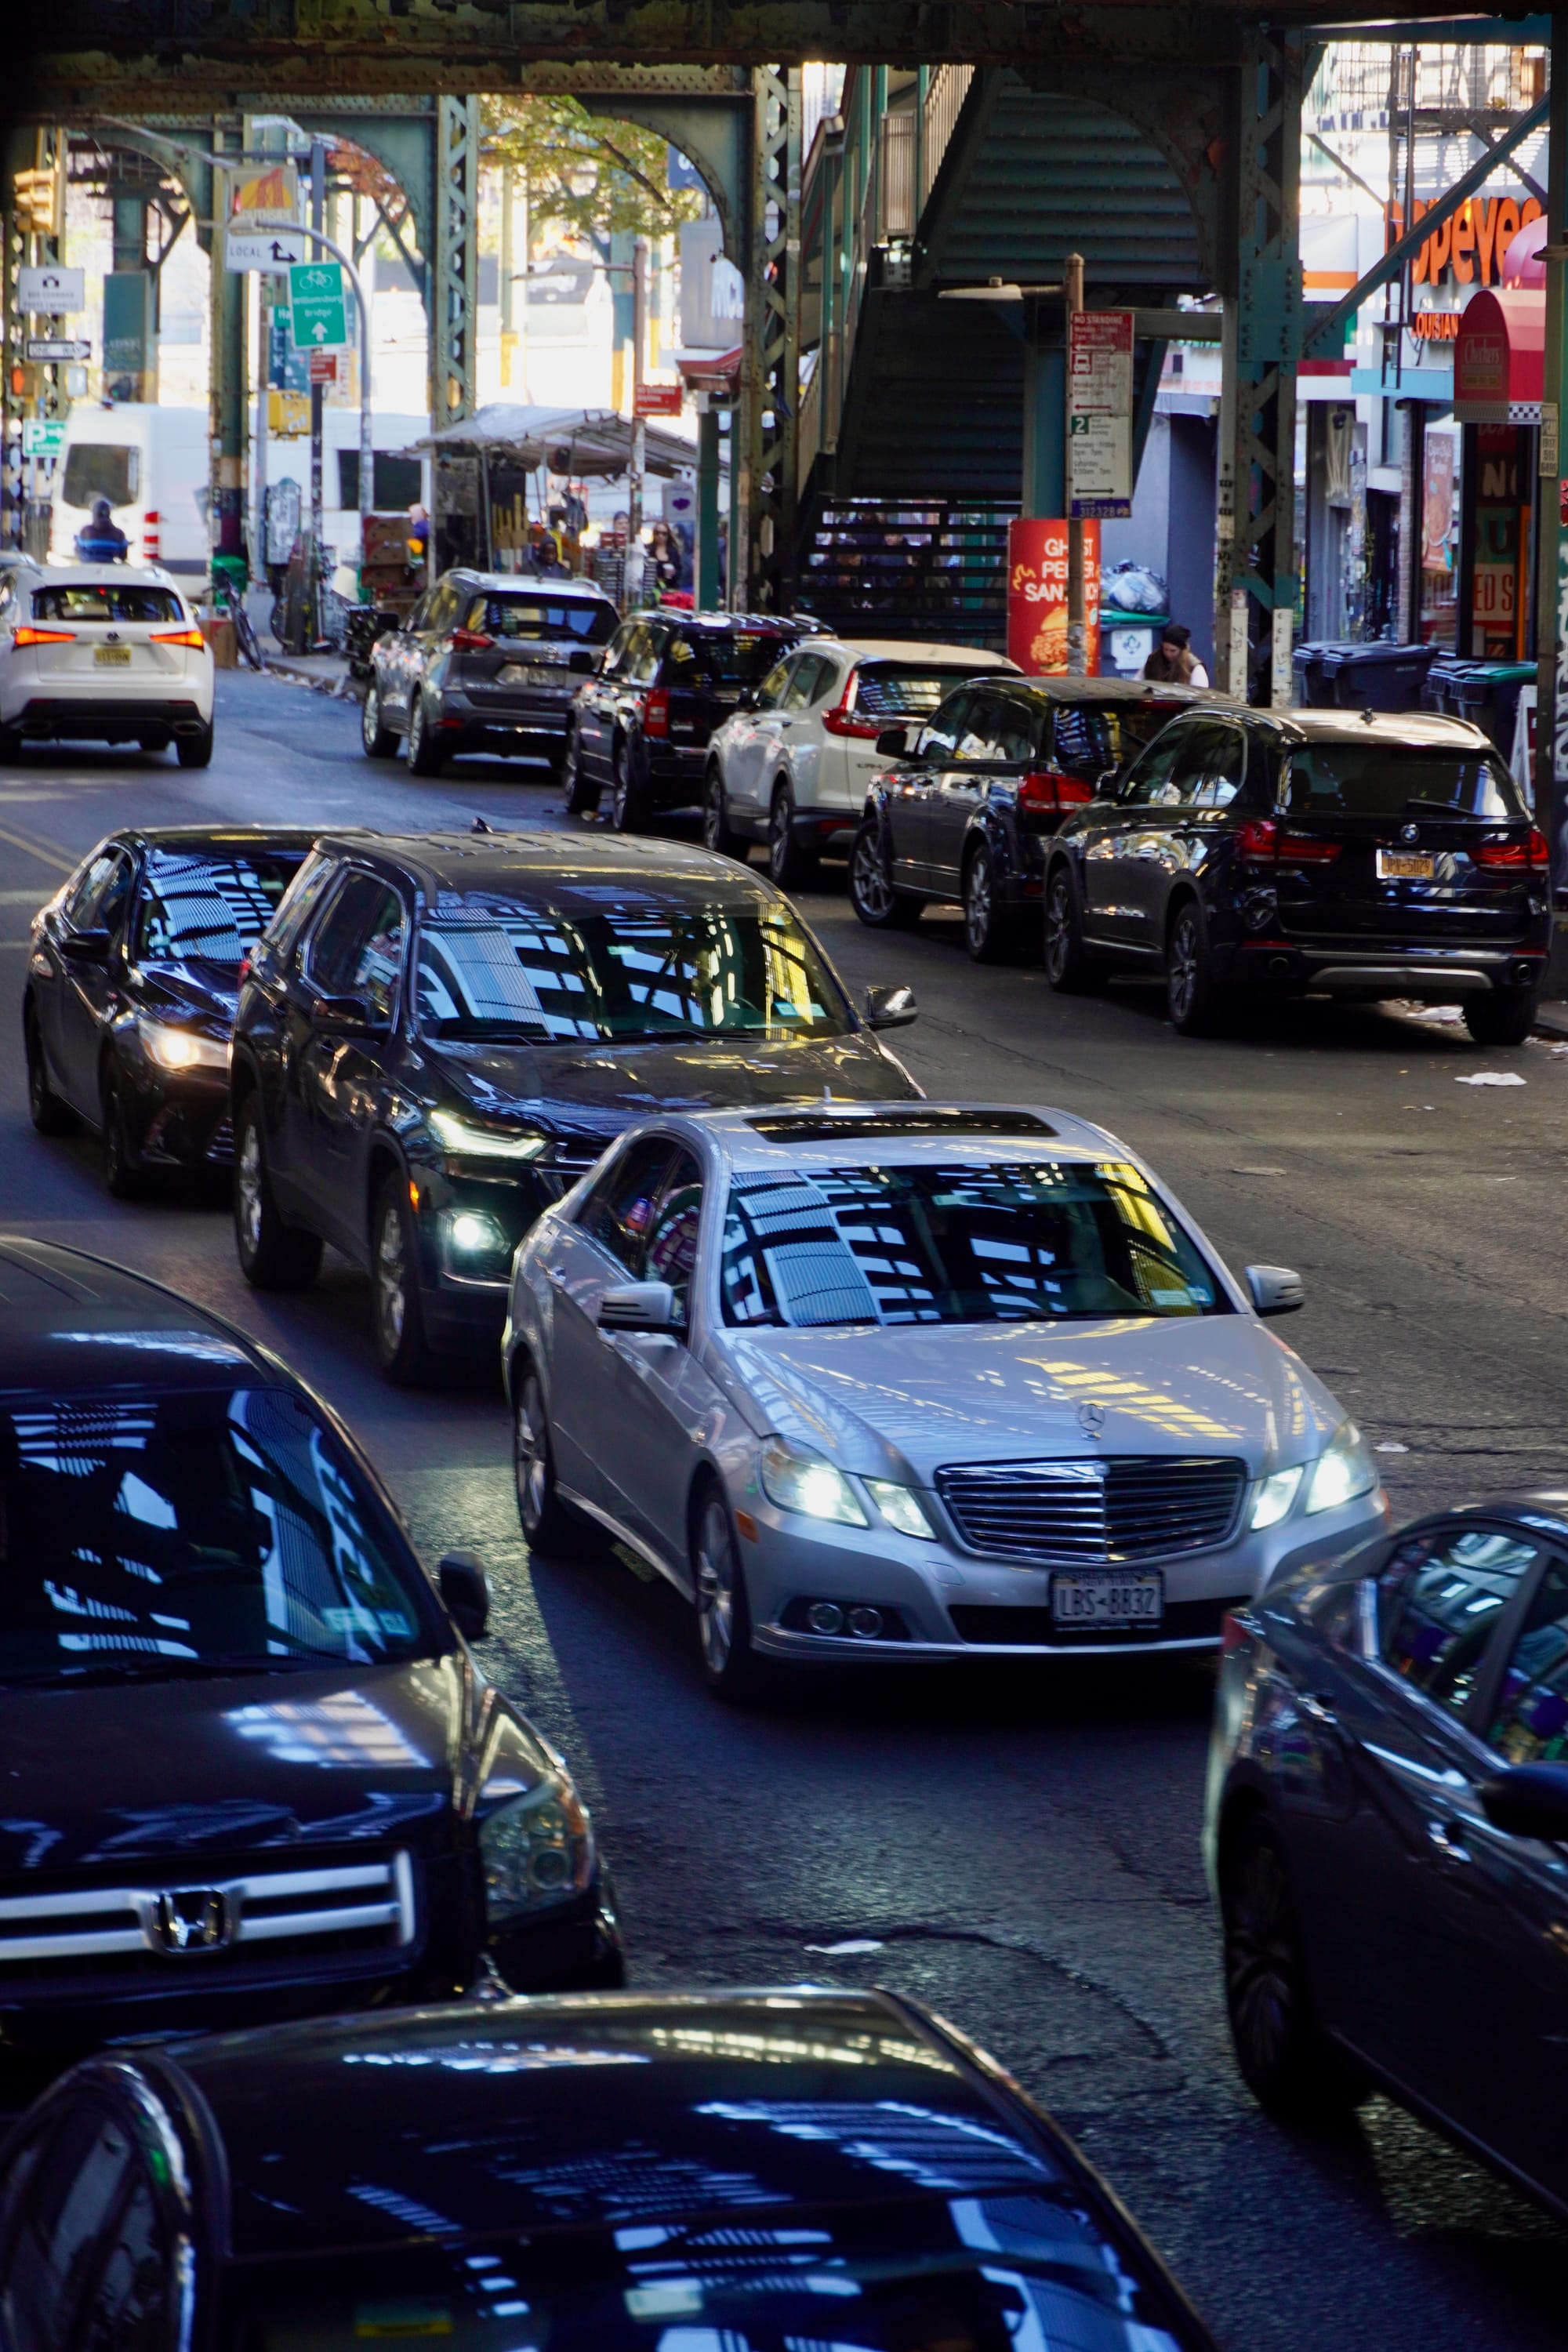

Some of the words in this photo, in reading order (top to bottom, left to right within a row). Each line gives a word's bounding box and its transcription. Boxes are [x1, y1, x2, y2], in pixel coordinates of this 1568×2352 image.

[230, 245, 262, 258] LOCAL
[1074, 315, 1085, 324] NO
[1087, 315, 1123, 325] STANDING
[1411, 311, 1464, 341] OUISIAN
[1075, 416, 1086, 434] 2
[1044, 538, 1094, 557] GHST
[1041, 561, 1094, 579] PEER
[1025, 583, 1098, 602] SANICH
